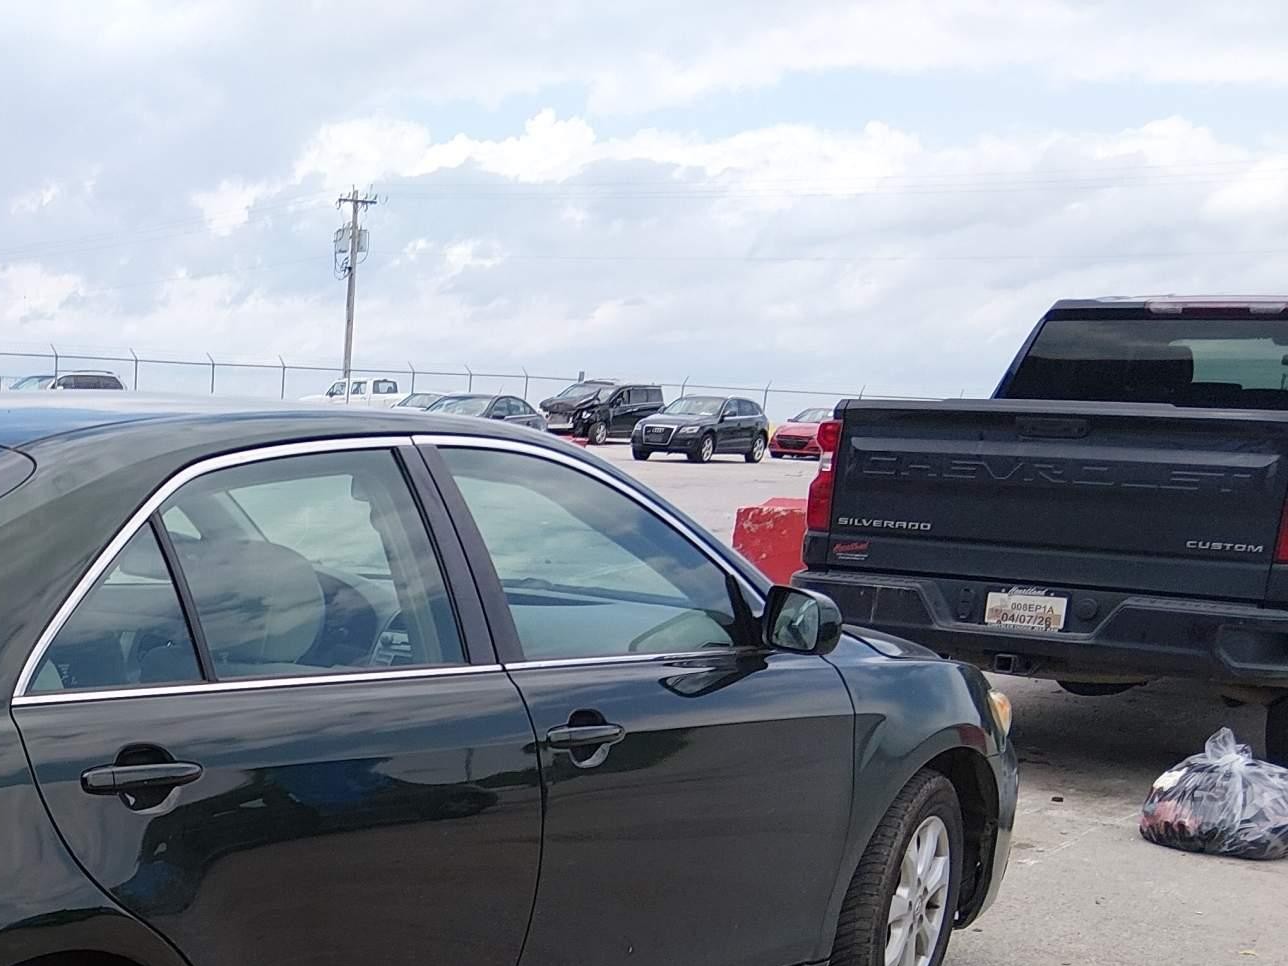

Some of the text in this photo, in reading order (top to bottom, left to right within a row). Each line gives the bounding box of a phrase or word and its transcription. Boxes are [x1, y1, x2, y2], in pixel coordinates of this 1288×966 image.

[838, 517, 932, 531] SILVERADO
[1186, 540, 1264, 553] CUSTOM
[1001, 612, 1052, 627] 04/07/26
